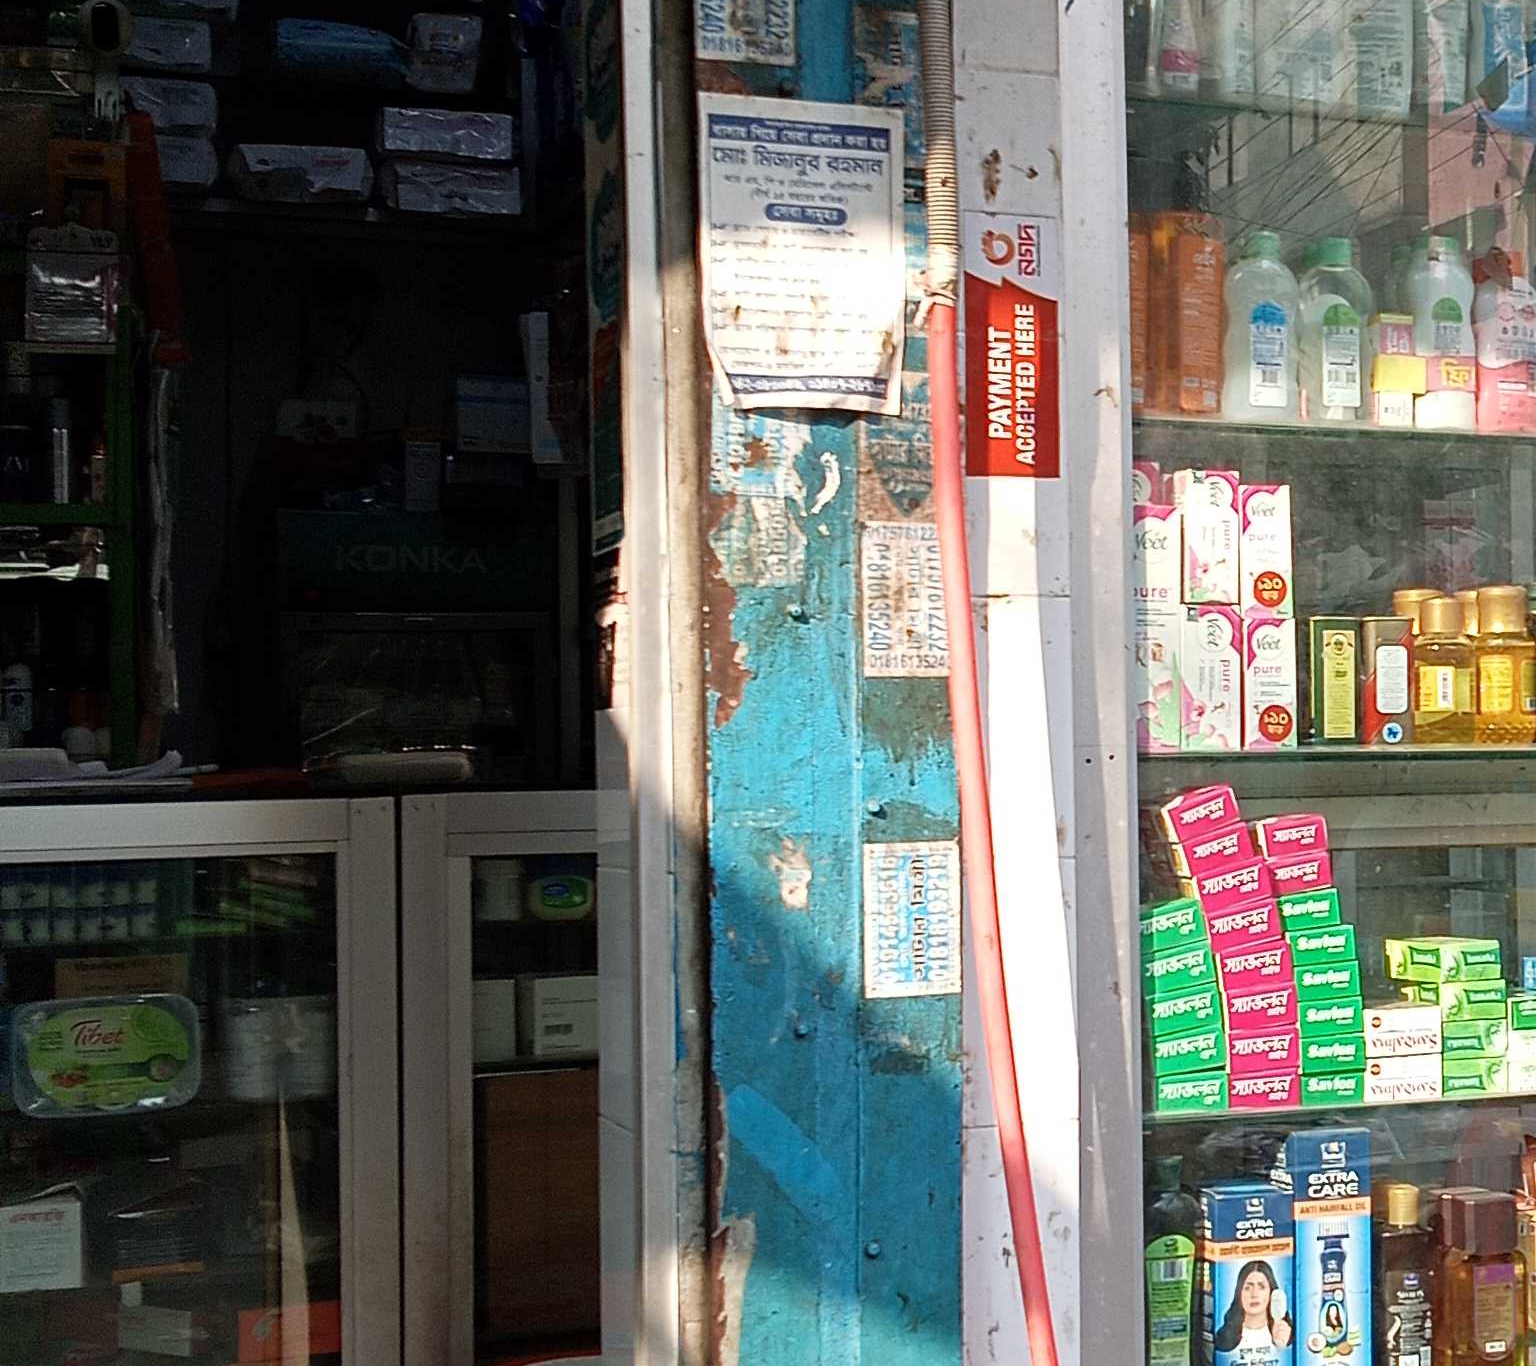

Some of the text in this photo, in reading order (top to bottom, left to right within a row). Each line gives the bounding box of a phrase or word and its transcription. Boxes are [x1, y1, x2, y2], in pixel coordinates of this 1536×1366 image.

[712, 144, 884, 178] মোঃ মিজানুর রহমান
[987, 324, 1013, 441] PAYMENT
[1013, 302, 1037, 467] ACCEPTED HERE
[1250, 501, 1277, 520] Veet
[1248, 531, 1277, 544] pure
[334, 543, 489, 574] KONKA
[1205, 616, 1221, 649] Veet
[1255, 633, 1283, 653] Veet
[1219, 658, 1232, 693] pure
[1253, 663, 1283, 678] pure
[1281, 897, 1332, 918] Savlon
[1296, 932, 1347, 952] Savlon
[1302, 968, 1351, 987] Savlon
[1305, 1004, 1356, 1023] Savlon
[70, 1018, 128, 1049] Tibet
[1307, 1041, 1357, 1060] Savlon
[1307, 1075, 1357, 1093] Savlon
[1308, 1171, 1359, 1185] EXTRA
[1308, 1183, 1359, 1198] CARE
[1235, 1227, 1275, 1240] CARE
[1236, 1219, 1275, 1230] EXTRA
